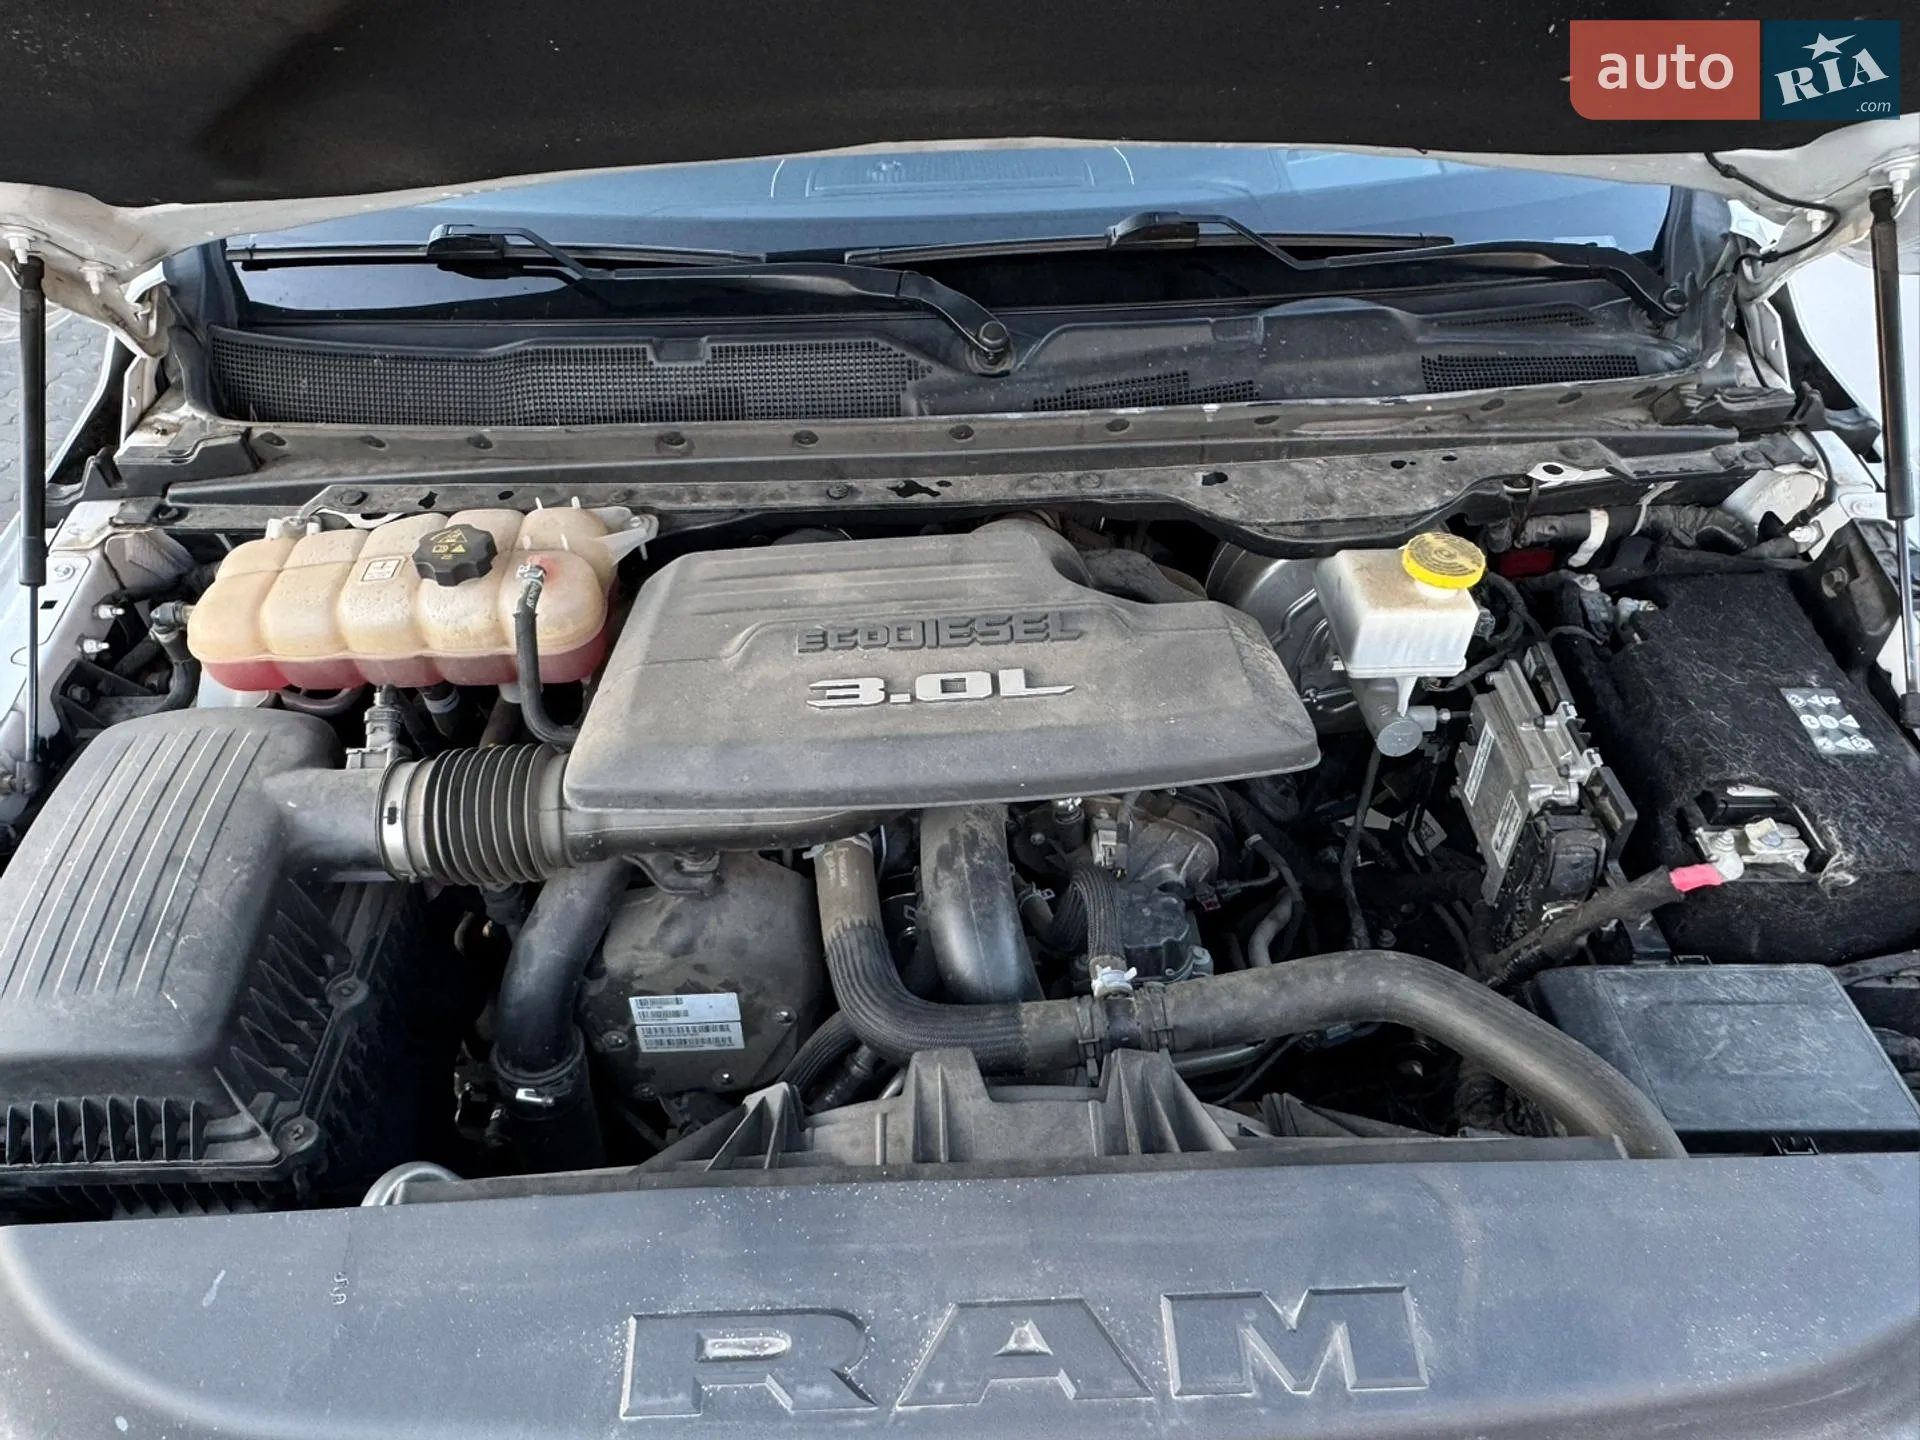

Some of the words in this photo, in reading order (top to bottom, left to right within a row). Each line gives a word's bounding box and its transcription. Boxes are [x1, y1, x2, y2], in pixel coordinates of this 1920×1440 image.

[797, 611, 1085, 654] ECODIESEL
[806, 667, 1077, 709] 3.0L
[620, 1285, 1430, 1421] RAM
